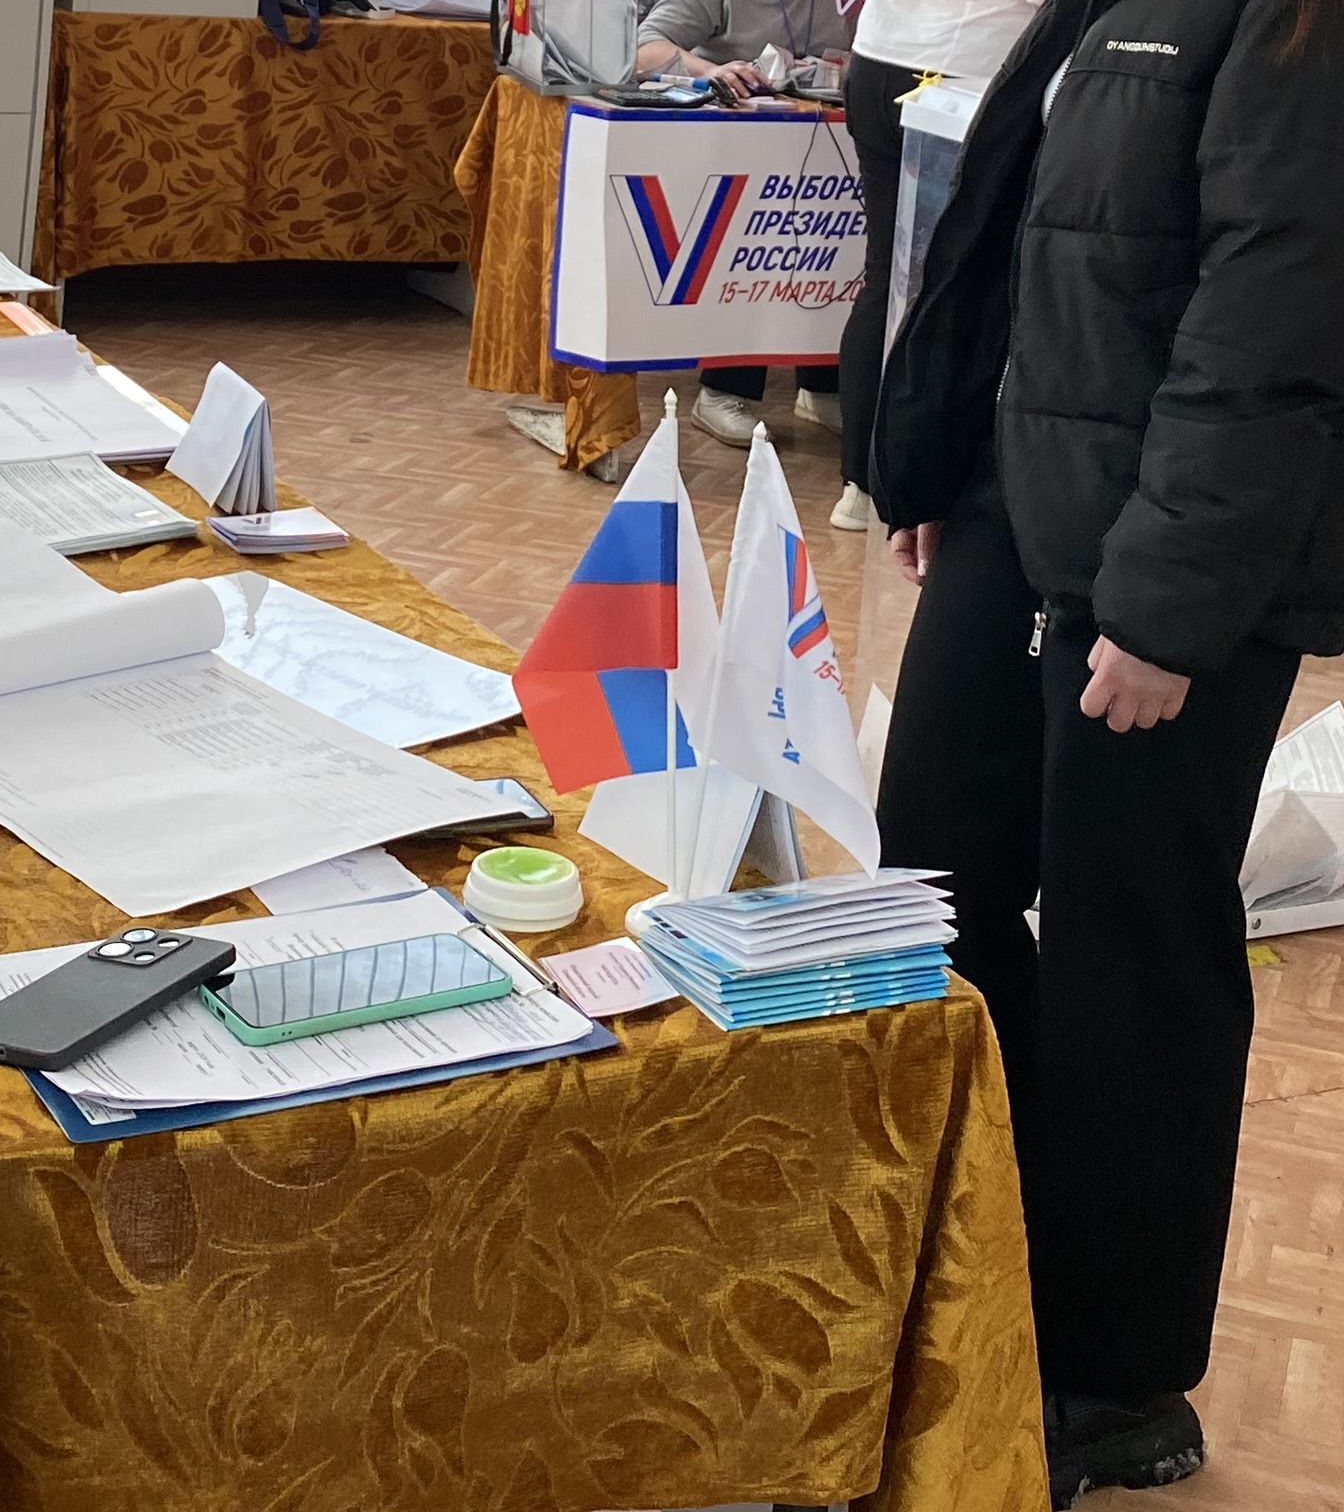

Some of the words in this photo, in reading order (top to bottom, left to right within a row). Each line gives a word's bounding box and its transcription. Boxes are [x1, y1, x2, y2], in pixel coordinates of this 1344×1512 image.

[744, 210, 869, 240] ПРЕЗИДЕ
[729, 246, 839, 272] РОССИИ
[769, 280, 836, 303] МАРТА
[838, 280, 865, 302] 20
